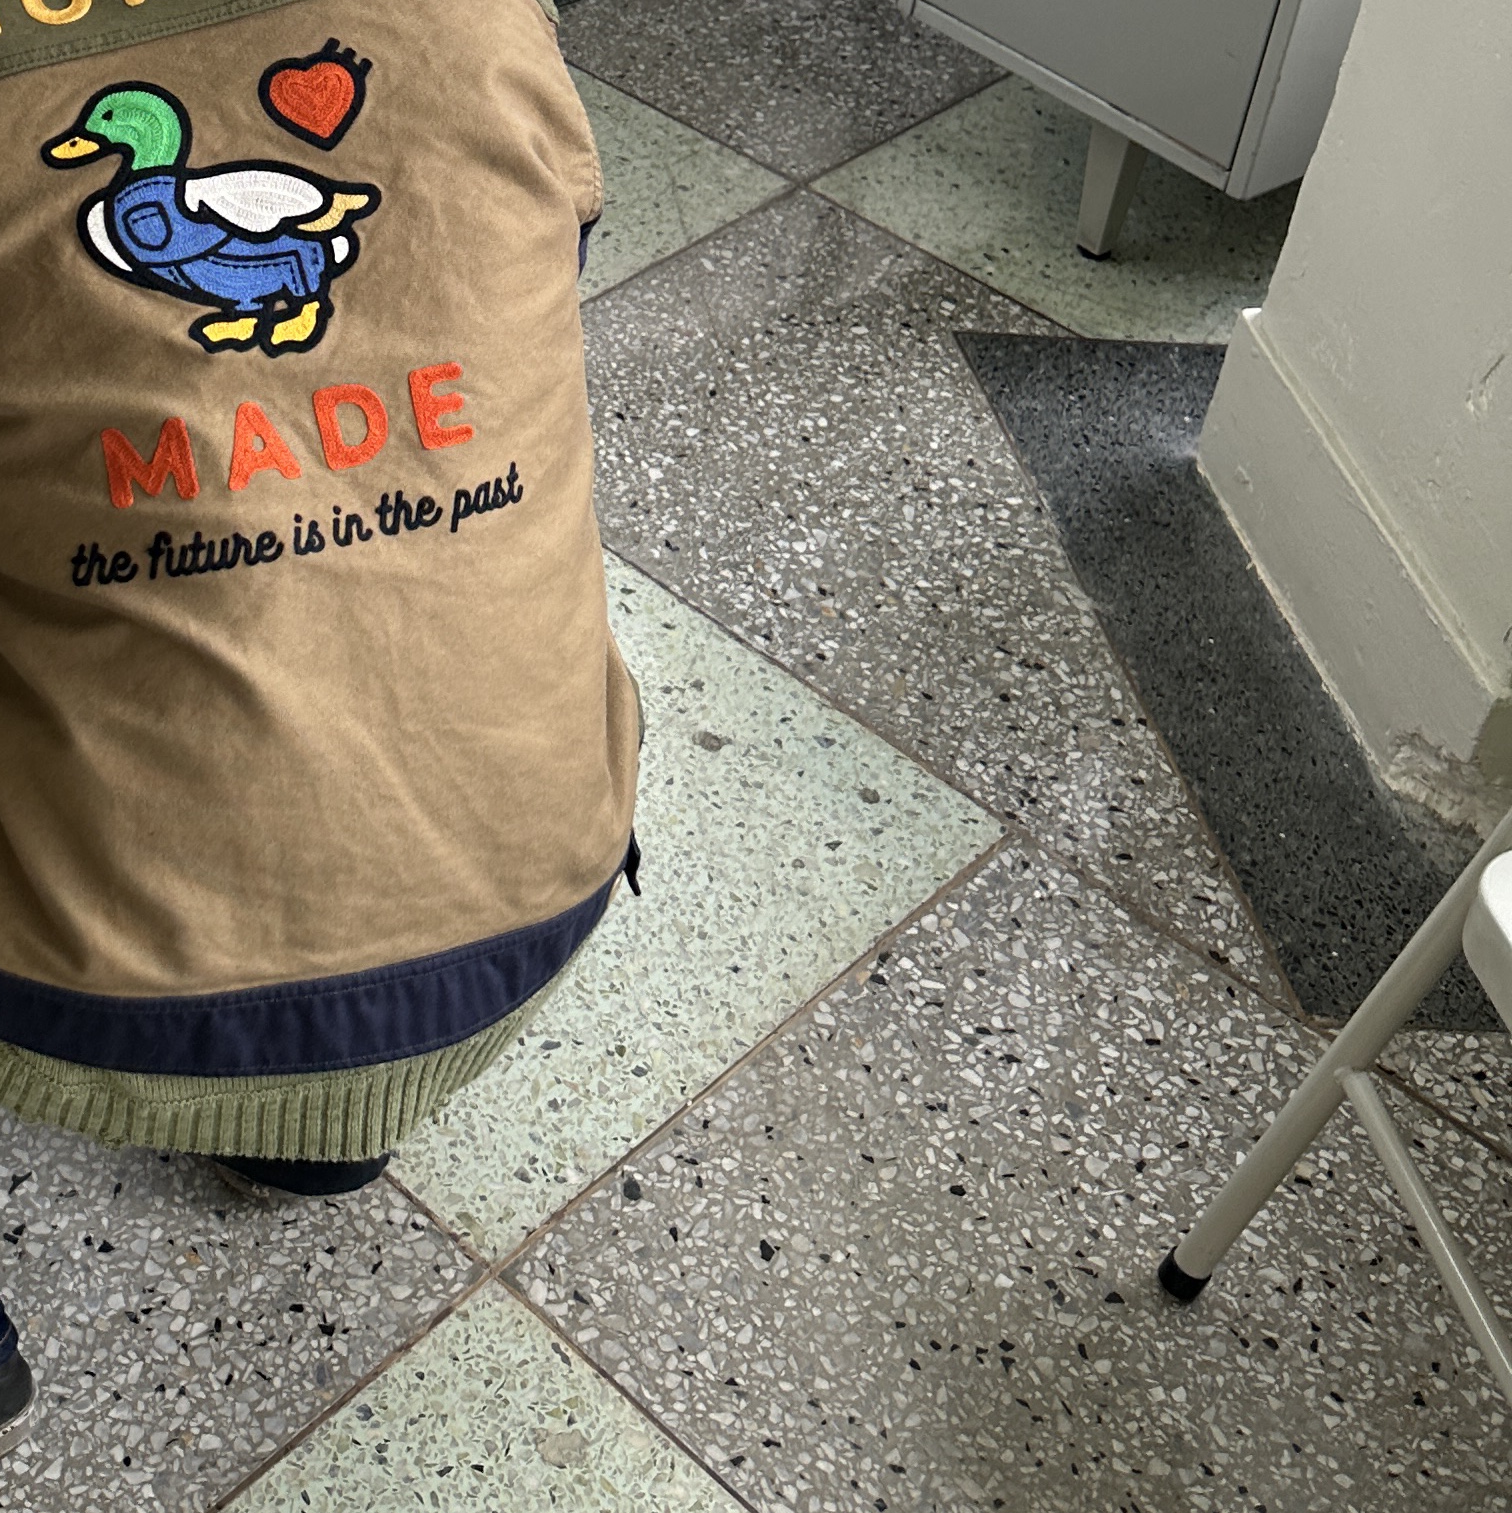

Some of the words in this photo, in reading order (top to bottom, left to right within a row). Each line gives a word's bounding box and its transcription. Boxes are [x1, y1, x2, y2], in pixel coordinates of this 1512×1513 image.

[100, 361, 475, 510] MADE
[70, 540, 139, 588] the
[147, 530, 284, 580] future
[293, 514, 325, 555] is
[332, 505, 373, 545] in
[376, 490, 444, 537] the
[449, 460, 524, 533] past
